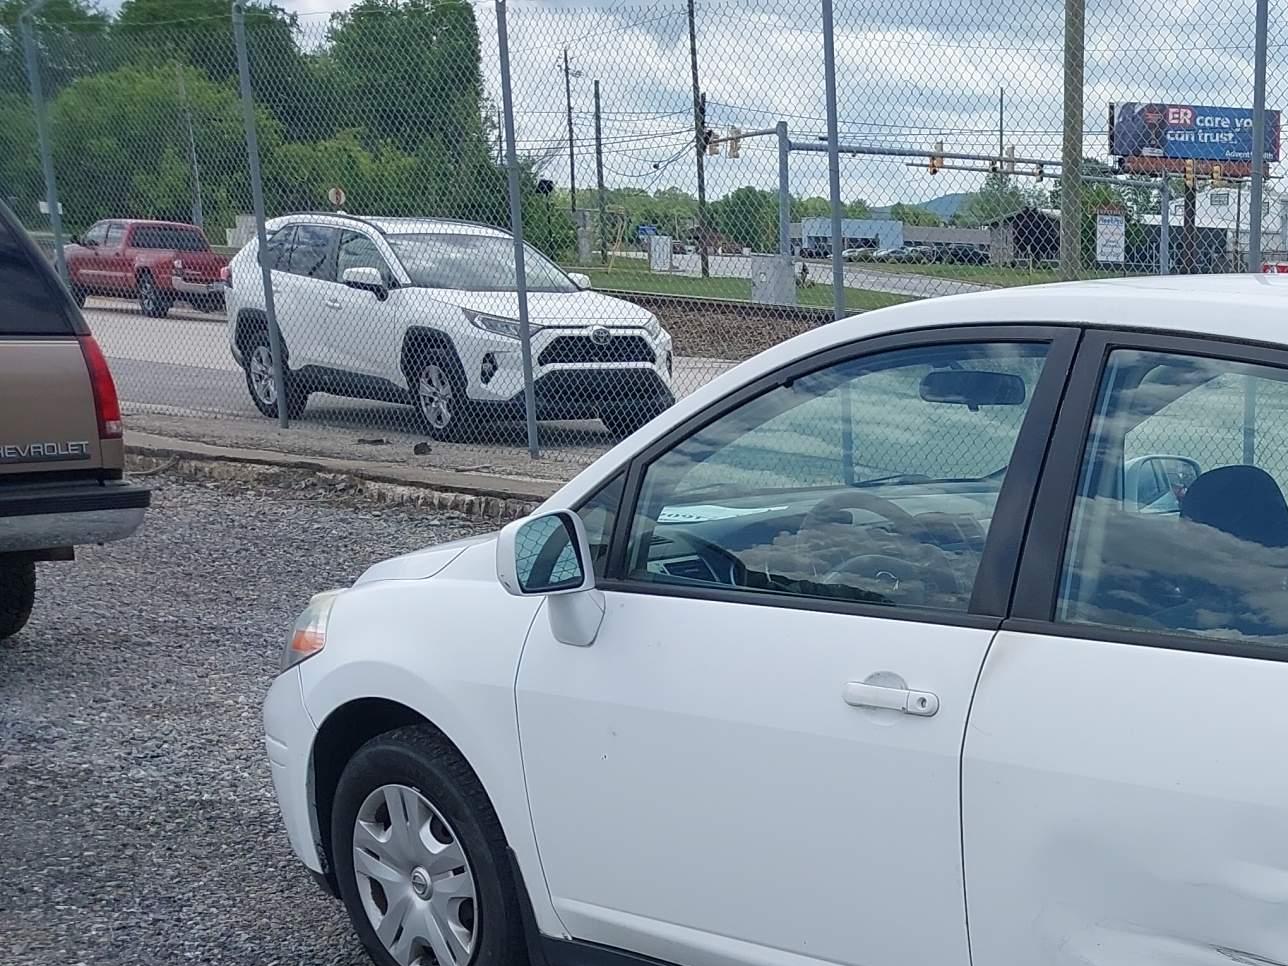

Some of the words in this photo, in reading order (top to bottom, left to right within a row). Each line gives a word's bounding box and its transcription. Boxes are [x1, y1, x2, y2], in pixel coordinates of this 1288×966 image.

[1169, 108, 1192, 124] ER
[1196, 116, 1230, 128] care
[1235, 118, 1253, 132] yo
[1167, 130, 1195, 142] can
[1198, 130, 1238, 144] trust.
